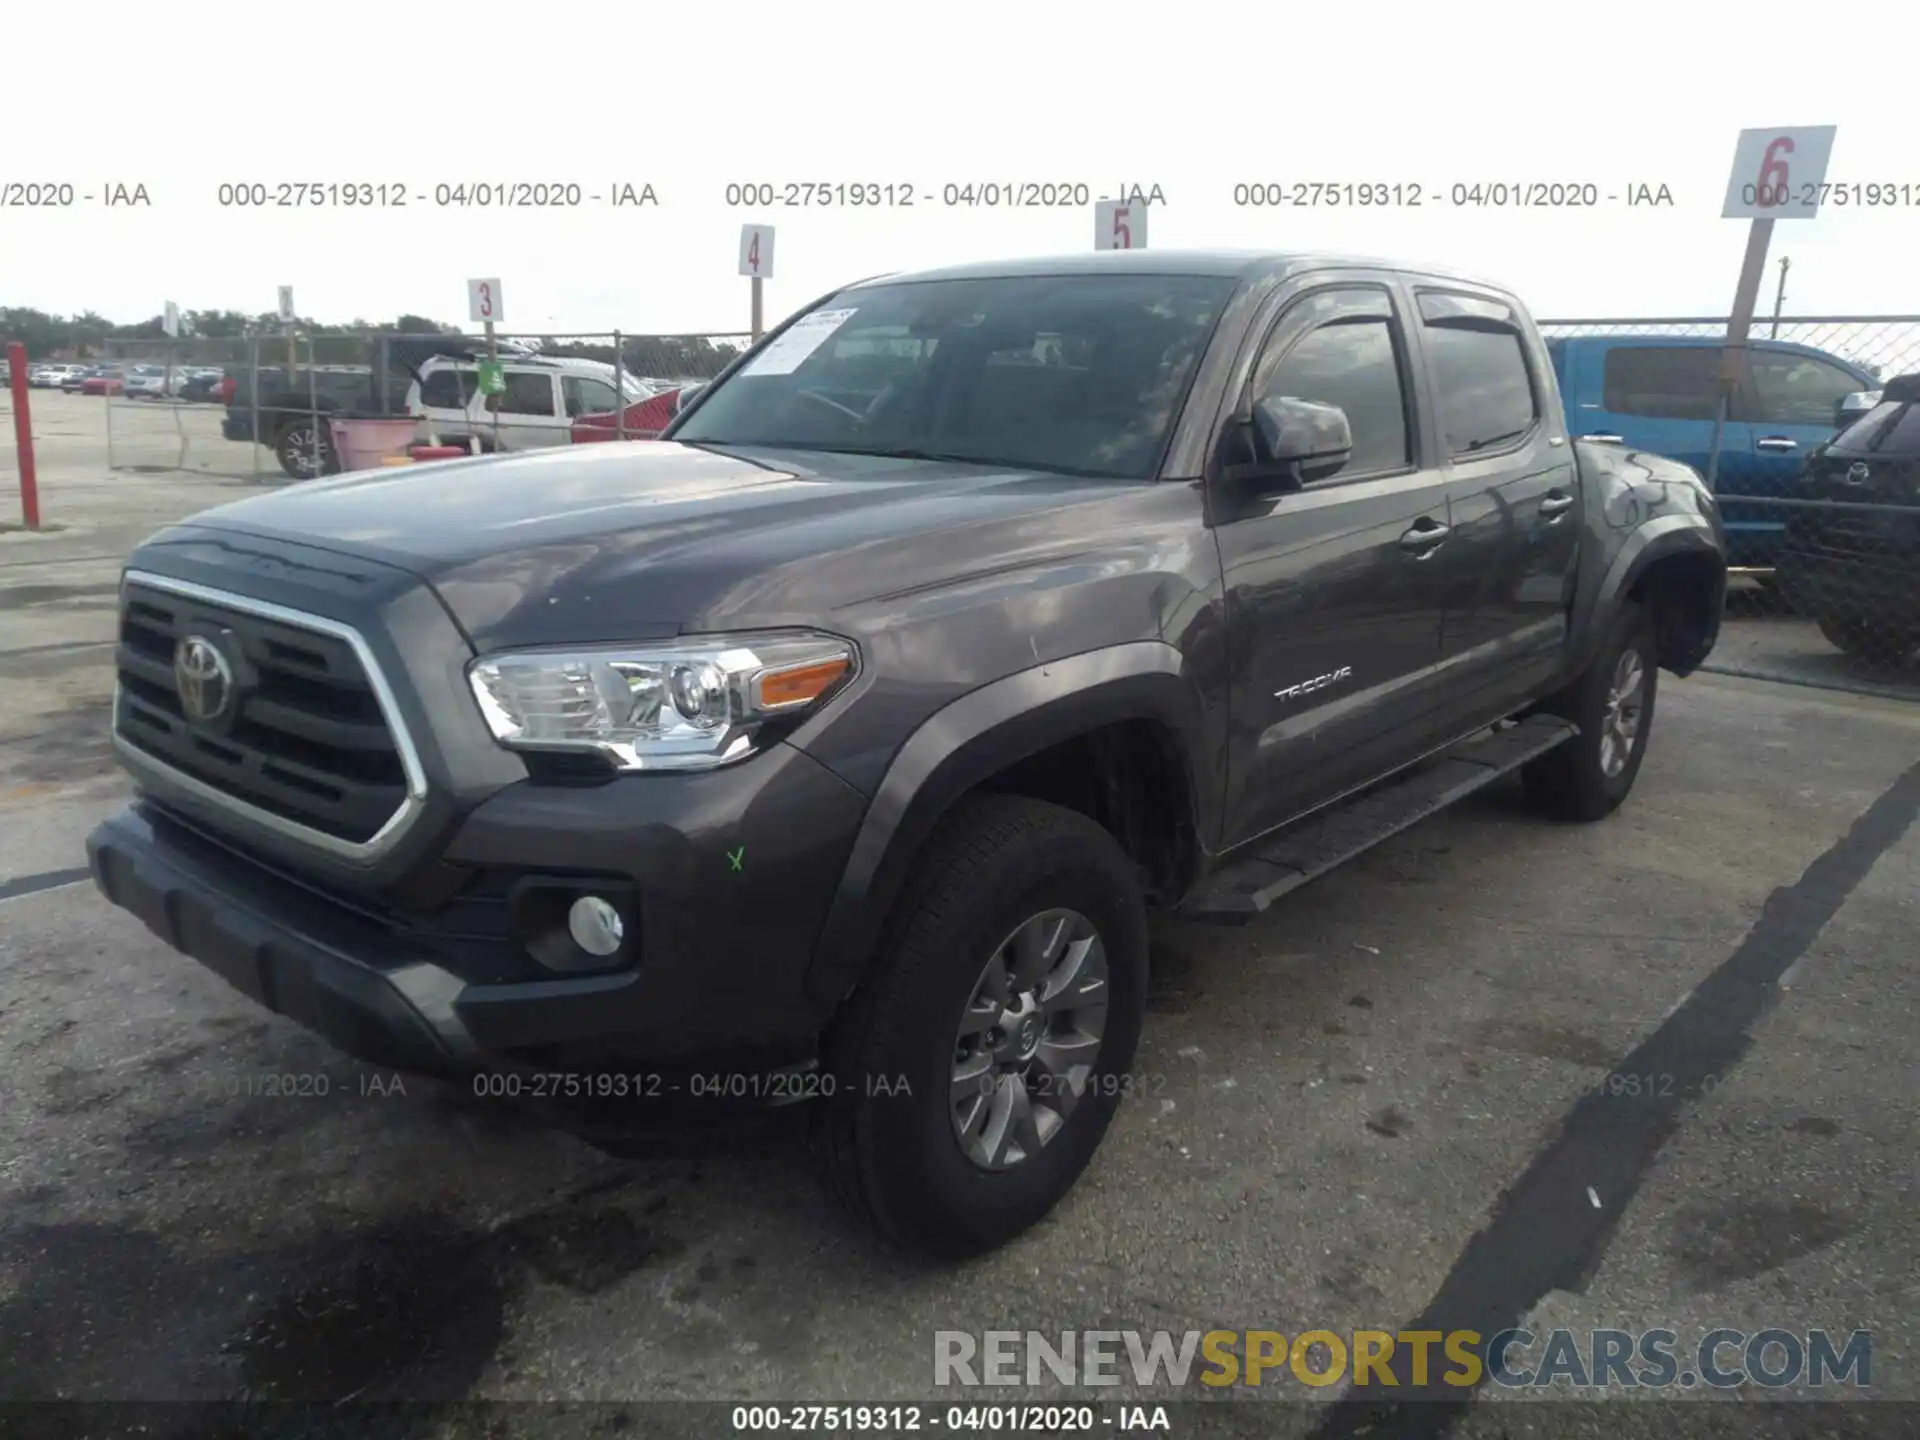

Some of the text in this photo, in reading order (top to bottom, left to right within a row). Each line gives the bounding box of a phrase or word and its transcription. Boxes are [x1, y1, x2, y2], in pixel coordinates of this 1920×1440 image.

[1757, 136, 1795, 209] 6
[1113, 207, 1131, 249] 5
[748, 231, 760, 273] 4
[479, 282, 493, 317] 3
